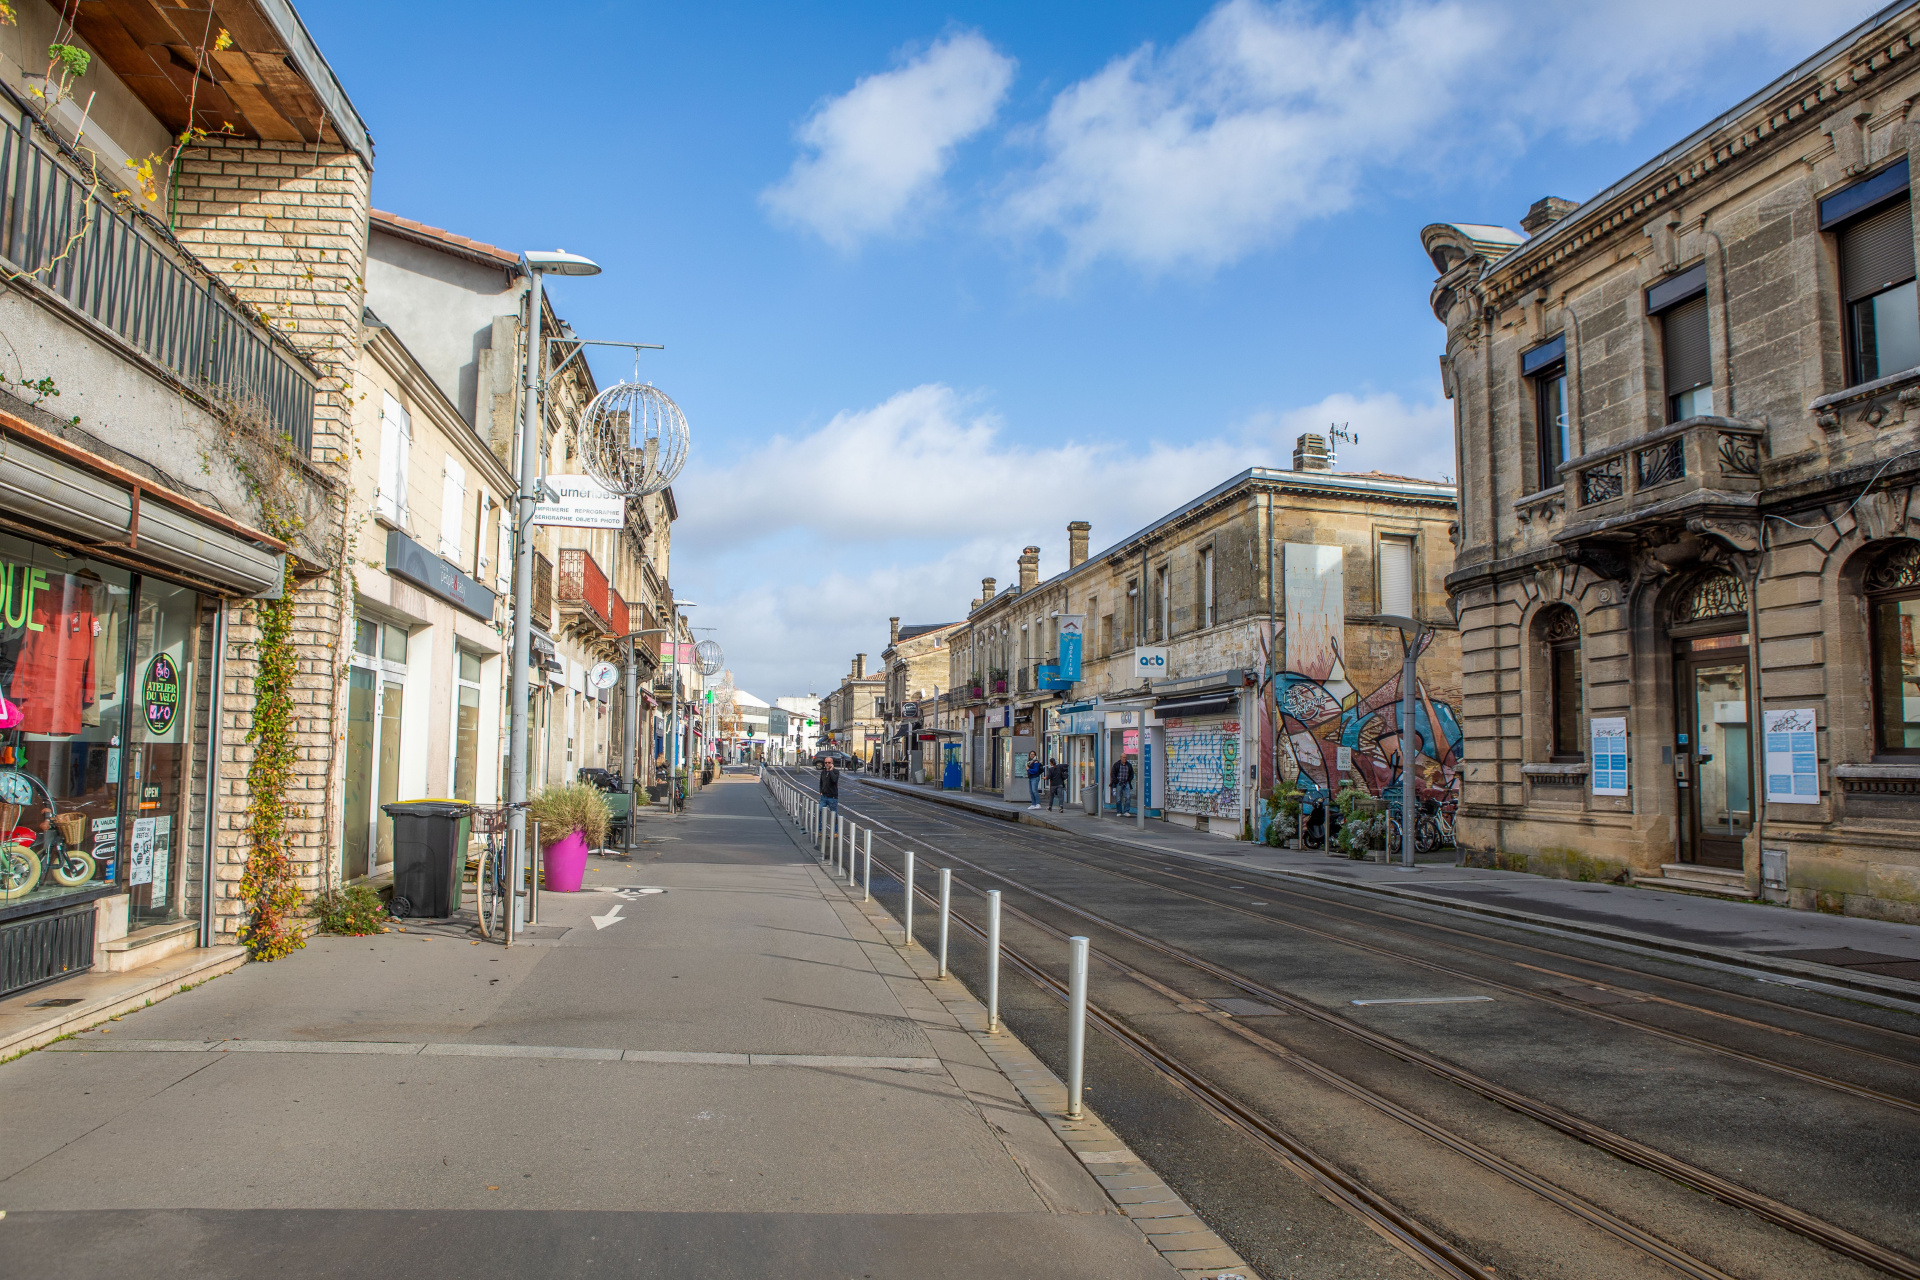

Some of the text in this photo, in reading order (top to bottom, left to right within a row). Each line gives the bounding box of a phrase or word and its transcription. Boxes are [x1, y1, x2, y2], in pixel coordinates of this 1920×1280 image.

[575, 508, 619, 516] REPROGRAPHIE
[0, 559, 50, 633] UE
[1139, 654, 1165, 667] acb
[146, 681, 177, 694] ATELIER
[146, 690, 157, 701] DU
[144, 786, 159, 798] OPEN
